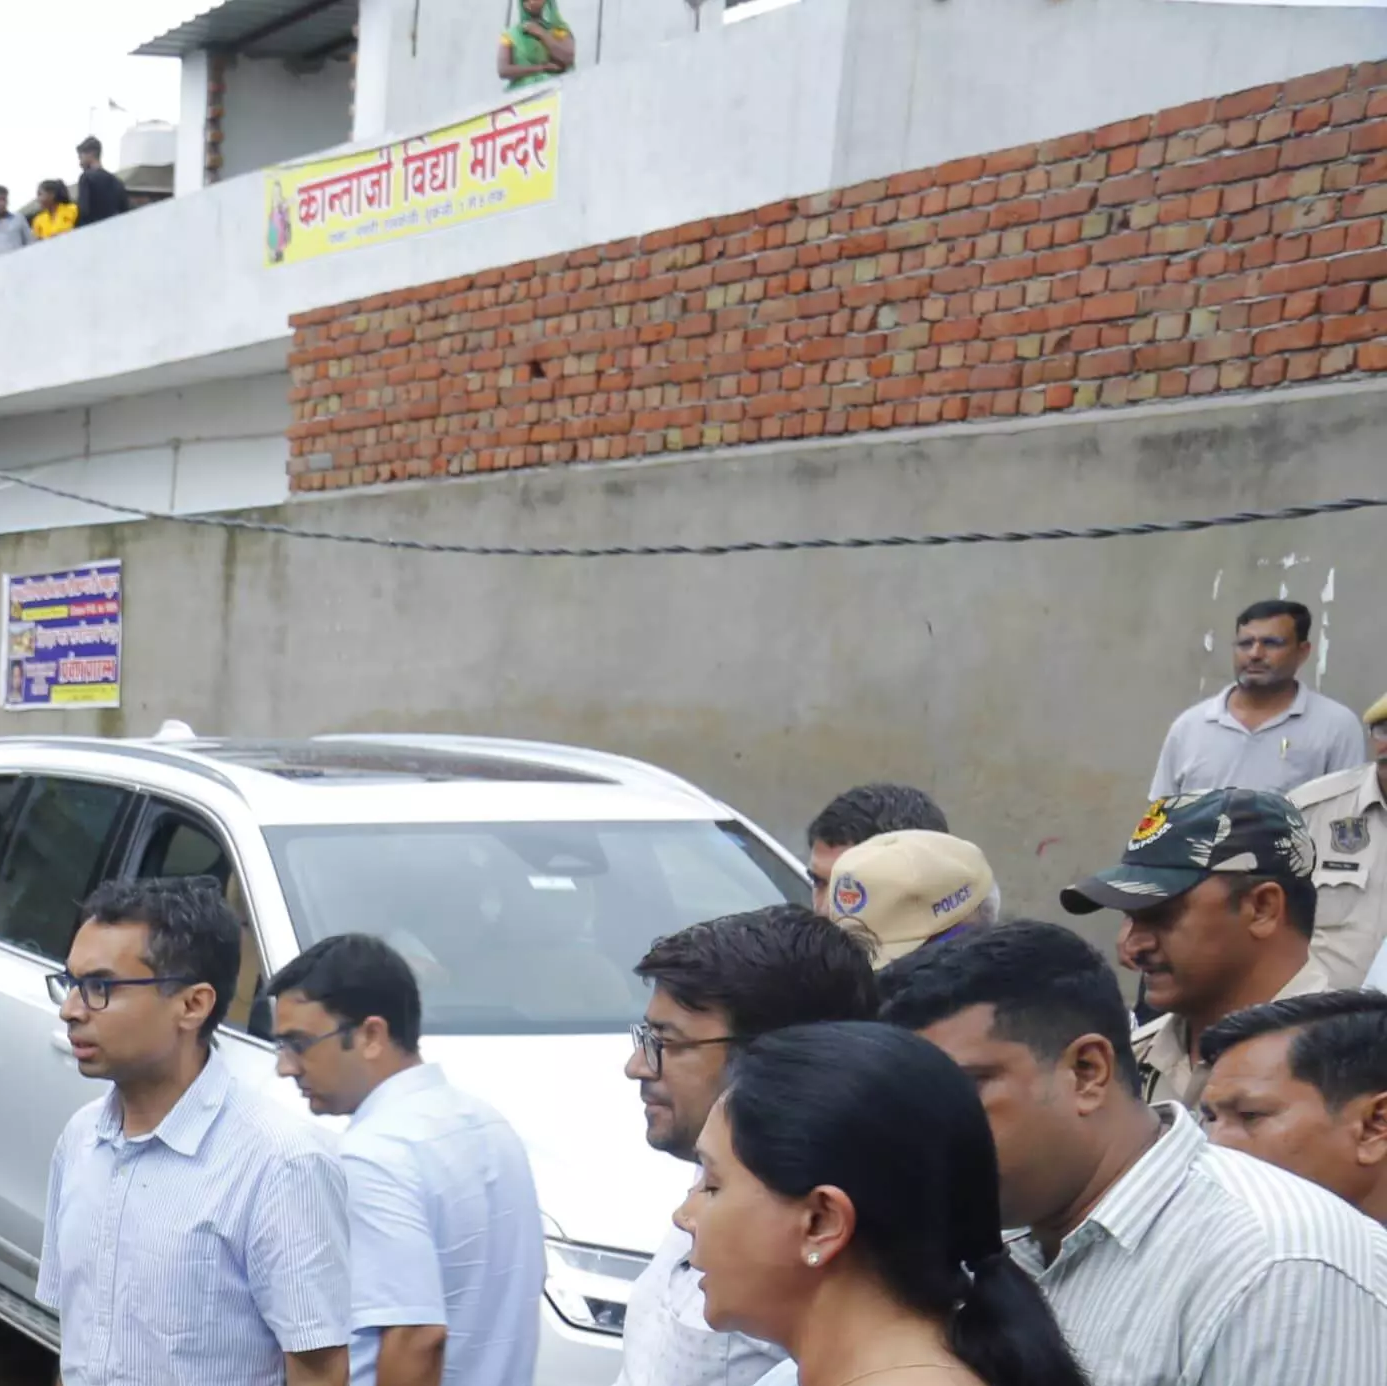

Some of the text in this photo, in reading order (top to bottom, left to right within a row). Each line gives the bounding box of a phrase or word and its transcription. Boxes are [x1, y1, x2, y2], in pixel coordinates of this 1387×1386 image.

[403, 136, 460, 202] विद्या
[470, 105, 550, 181] मन्दिर
[932, 885, 972, 918] POLICE
